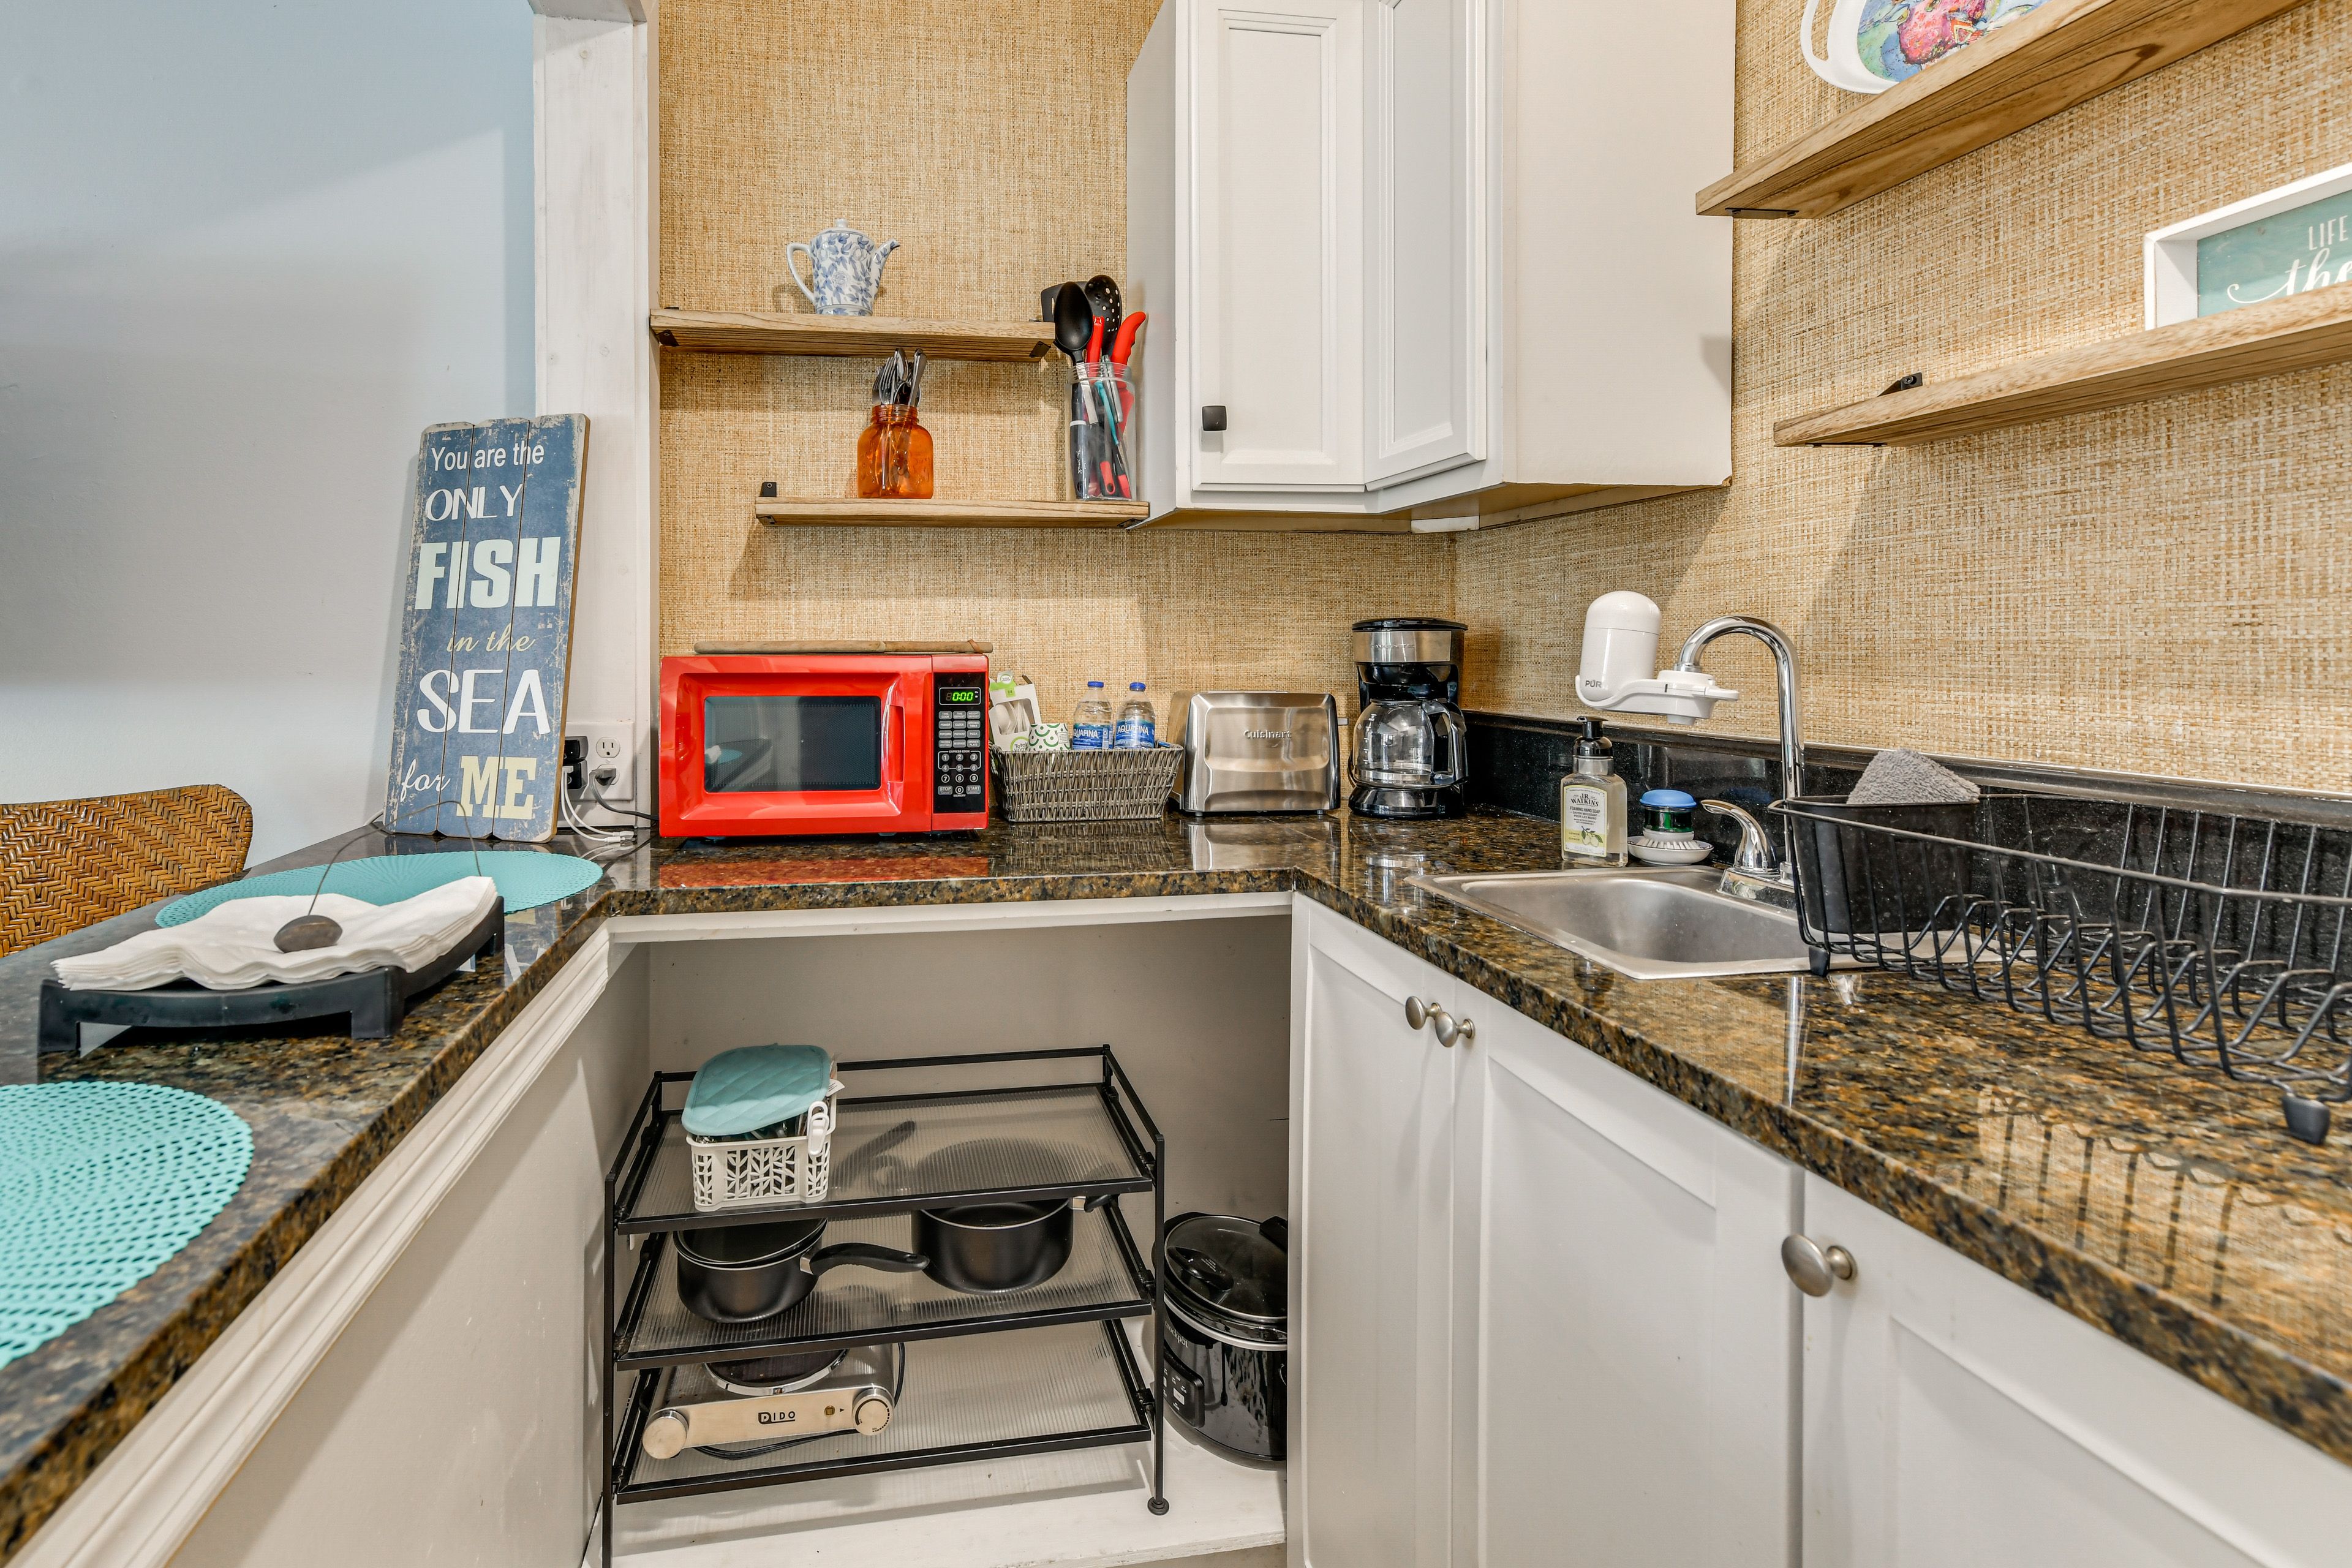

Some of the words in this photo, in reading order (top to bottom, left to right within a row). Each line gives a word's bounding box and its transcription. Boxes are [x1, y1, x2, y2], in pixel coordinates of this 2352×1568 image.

[2309, 216, 2348, 251] LIFE
[431, 447, 468, 472] You
[474, 448, 506, 469] are
[513, 440, 545, 466] the
[425, 484, 523, 521] ONLY
[415, 537, 560, 609] FISH
[447, 631, 479, 652] in
[486, 623, 536, 652] the
[417, 669, 551, 734] SEA
[1074, 729, 1099, 738] QUAFINA
[1117, 725, 1149, 735] AQUAFINA
[1244, 730, 1291, 739] Cuisinart
[400, 759, 451, 802] for
[456, 756, 537, 820] ME
